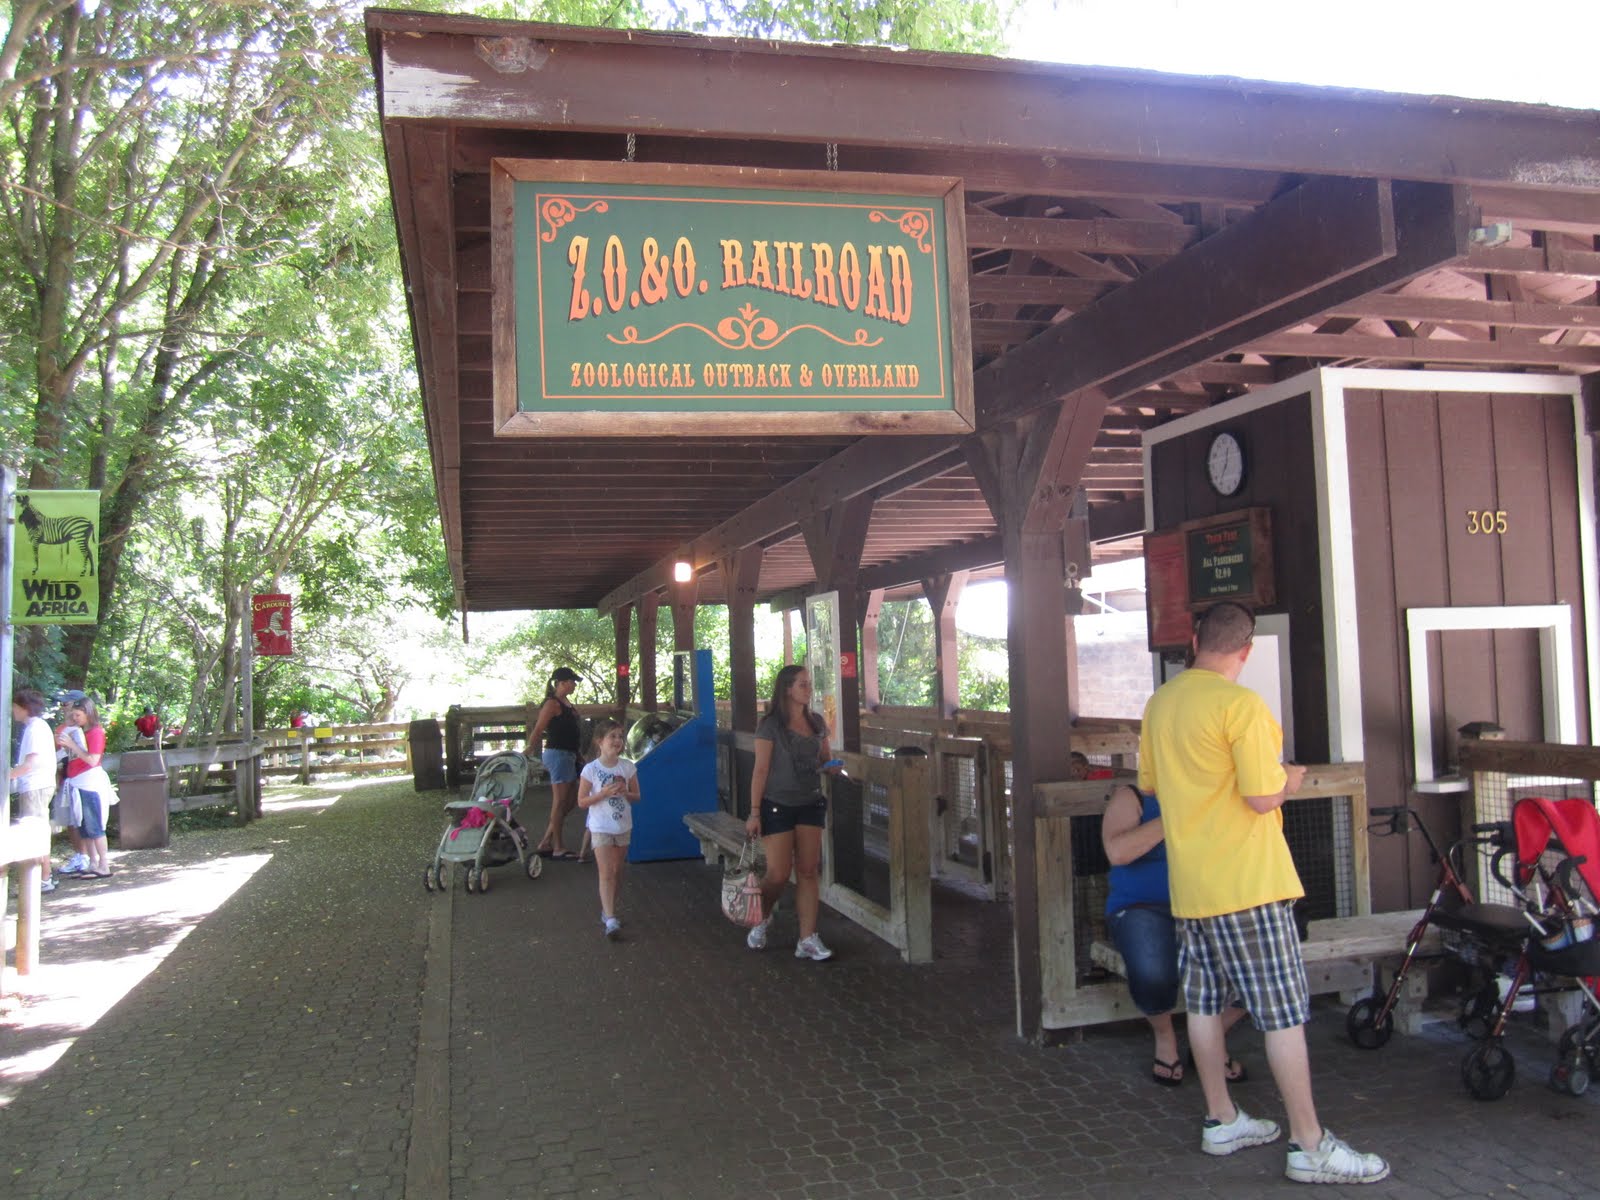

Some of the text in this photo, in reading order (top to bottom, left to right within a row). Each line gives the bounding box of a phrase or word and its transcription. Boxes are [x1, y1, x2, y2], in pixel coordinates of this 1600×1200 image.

[568, 234, 913, 325] Z.O.&O. RAILROAD
[570, 361, 921, 388] ZOOLOGICAL OUTBACK & OVERLAND
[1467, 510, 1508, 534] 305
[22, 578, 82, 601] WILD
[25, 601, 89, 617] AFRICA
[254, 602, 290, 611] CAROUSEL
